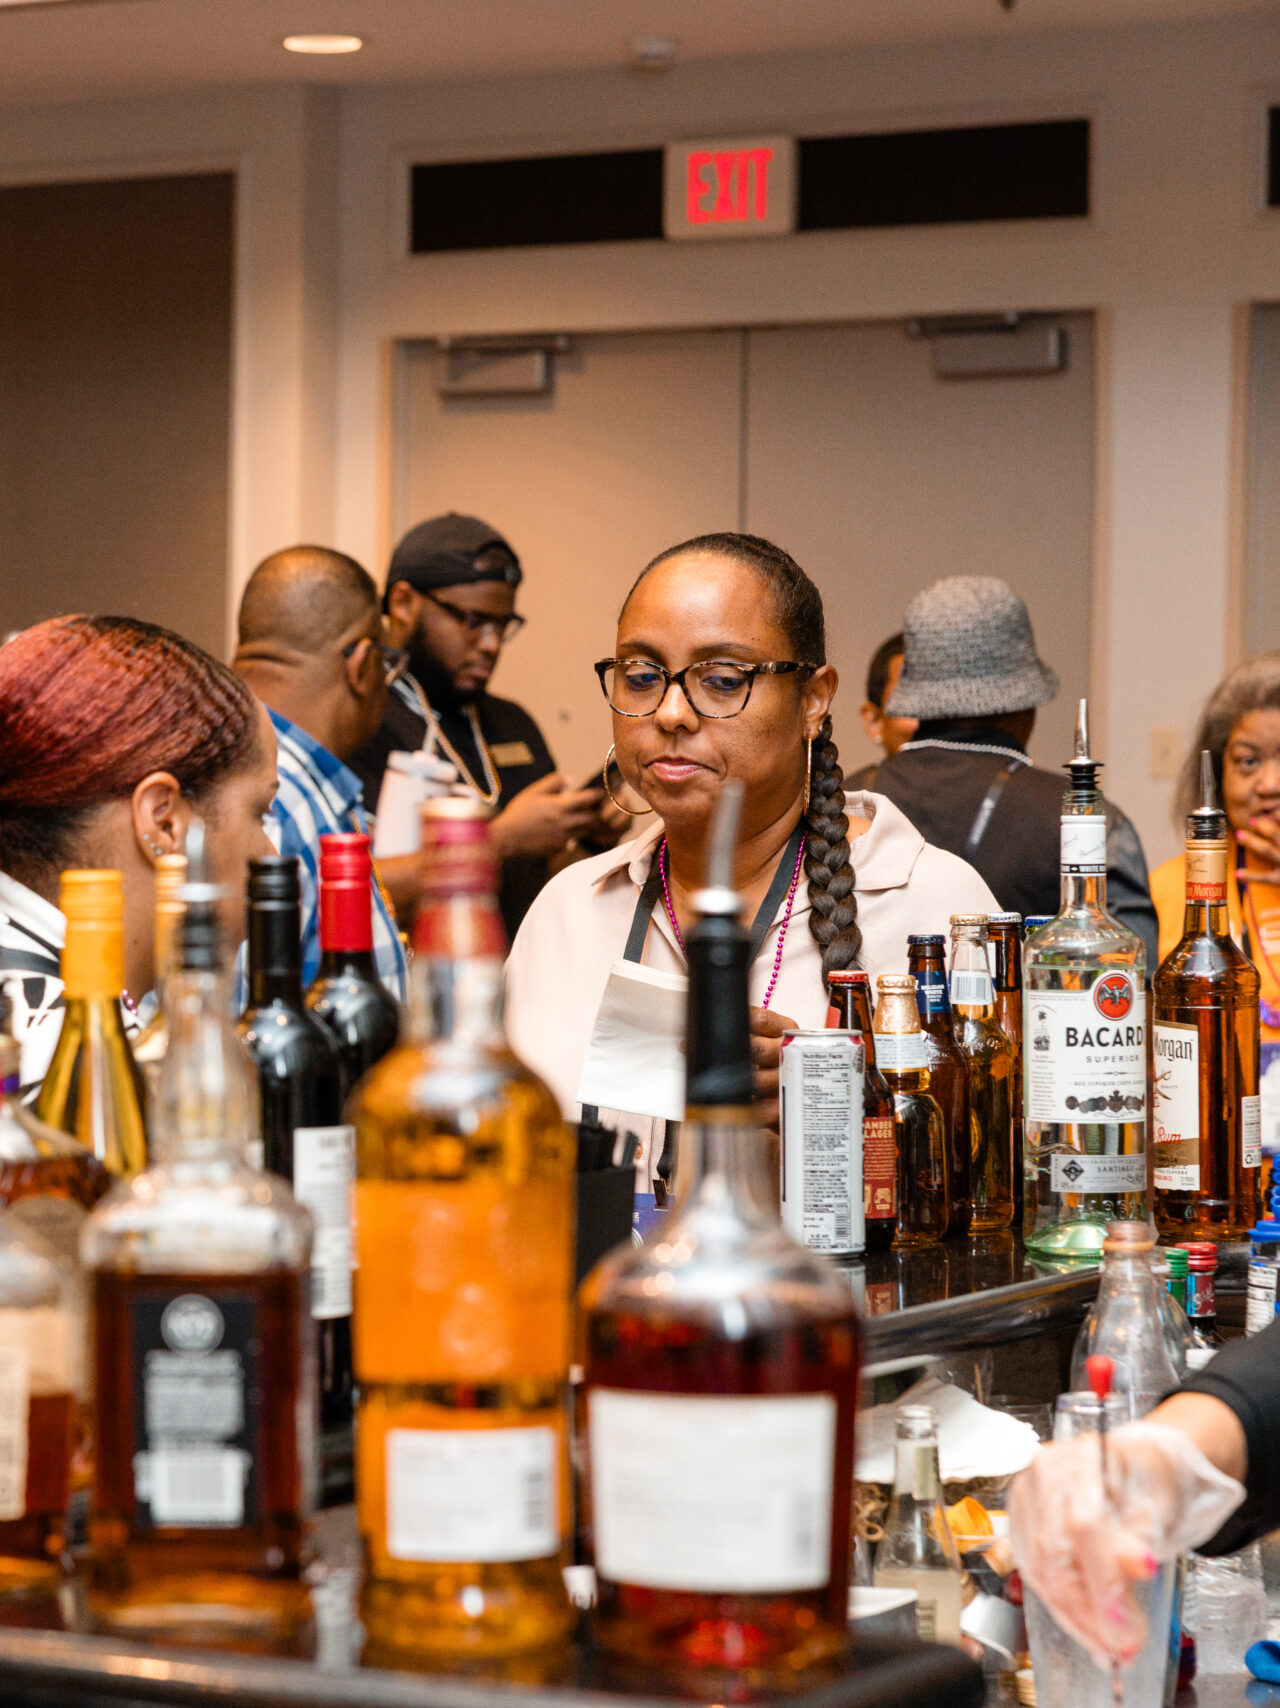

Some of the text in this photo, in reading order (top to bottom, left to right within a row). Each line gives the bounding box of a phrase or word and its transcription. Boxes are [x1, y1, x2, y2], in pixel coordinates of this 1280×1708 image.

[687, 147, 774, 225] EXIT
[864, 1120, 892, 1129] AMBER
[863, 1129, 892, 1139] LAGER
[1157, 1126, 1183, 1145] Rum
